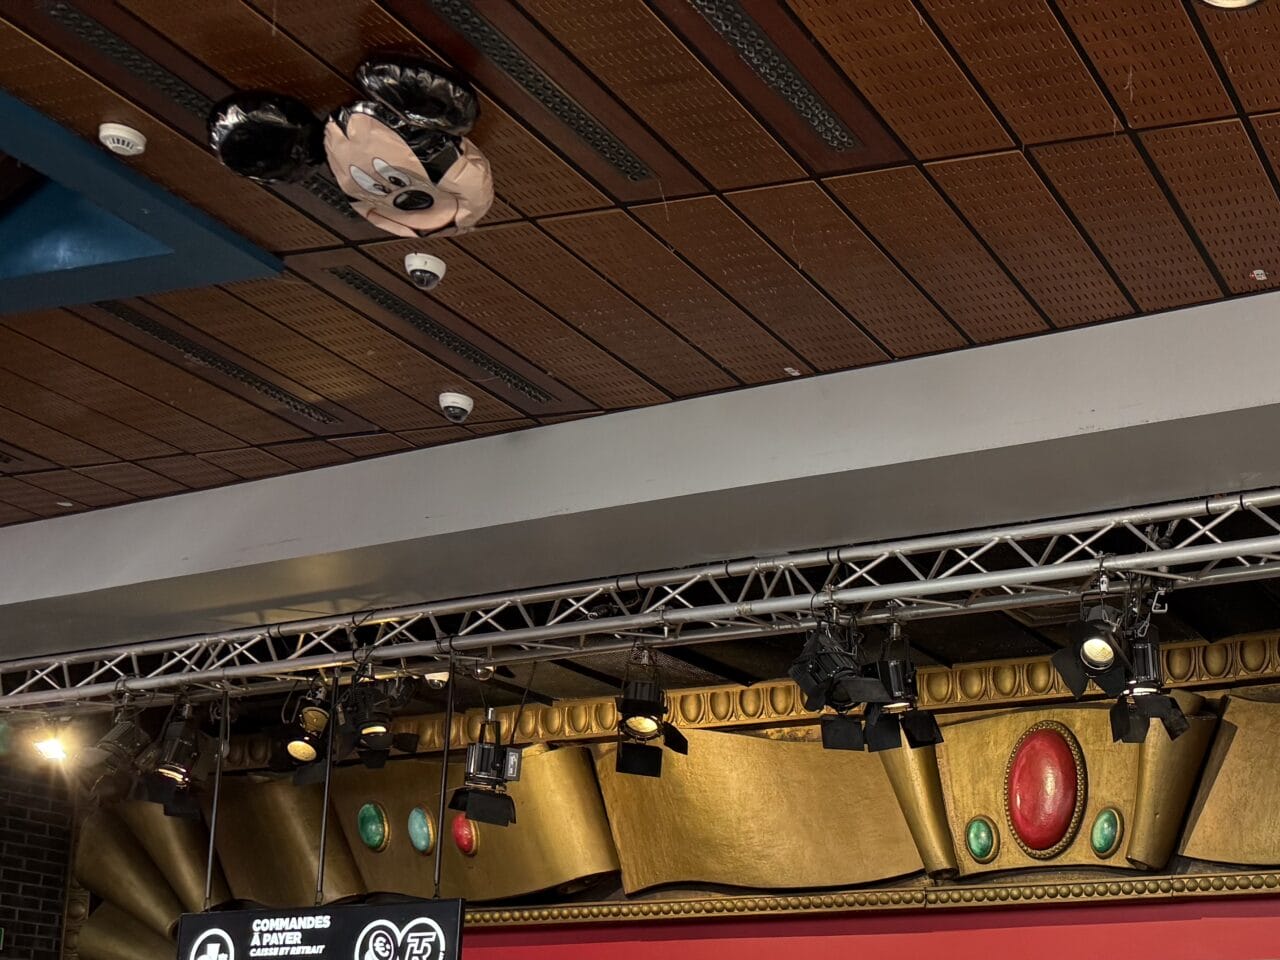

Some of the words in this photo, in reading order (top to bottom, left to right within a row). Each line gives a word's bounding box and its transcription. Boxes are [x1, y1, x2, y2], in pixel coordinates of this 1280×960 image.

[252, 916, 331, 932] COMMANDES
[251, 933, 260, 945] À
[263, 932, 302, 945] PAYER
